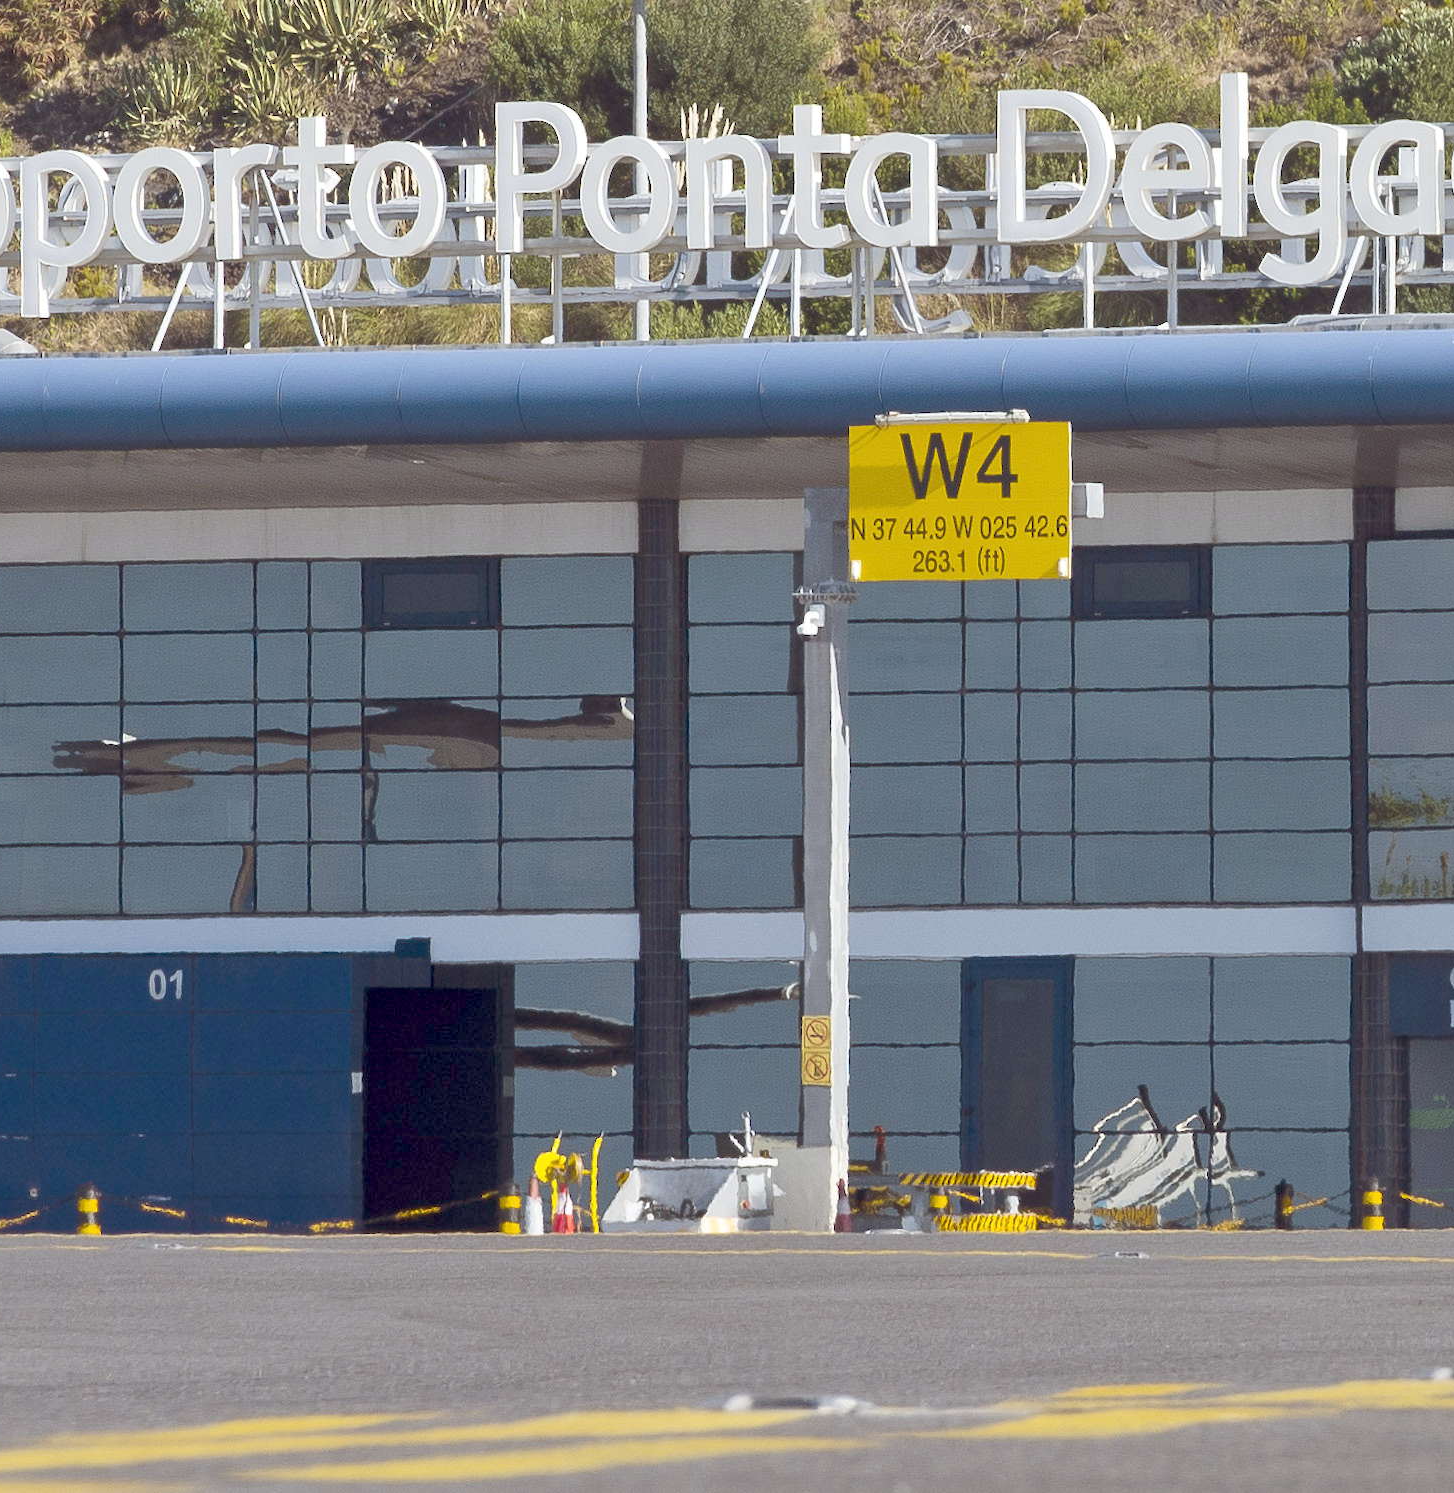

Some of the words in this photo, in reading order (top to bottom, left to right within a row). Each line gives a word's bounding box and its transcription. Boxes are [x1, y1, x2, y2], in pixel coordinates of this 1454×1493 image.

[495, 101, 938, 254] Ponta
[900, 431, 1018, 500] W4
[851, 517, 866, 541] N
[873, 517, 895, 540] 37
[903, 516, 946, 540] 44.9
[953, 515, 974, 539] W
[980, 515, 1017, 539] 025
[1024, 514, 1068, 539] 42.6
[913, 549, 967, 573] 263.1
[977, 546, 1006, 575] (ft)
[148, 969, 184, 1001] 01
